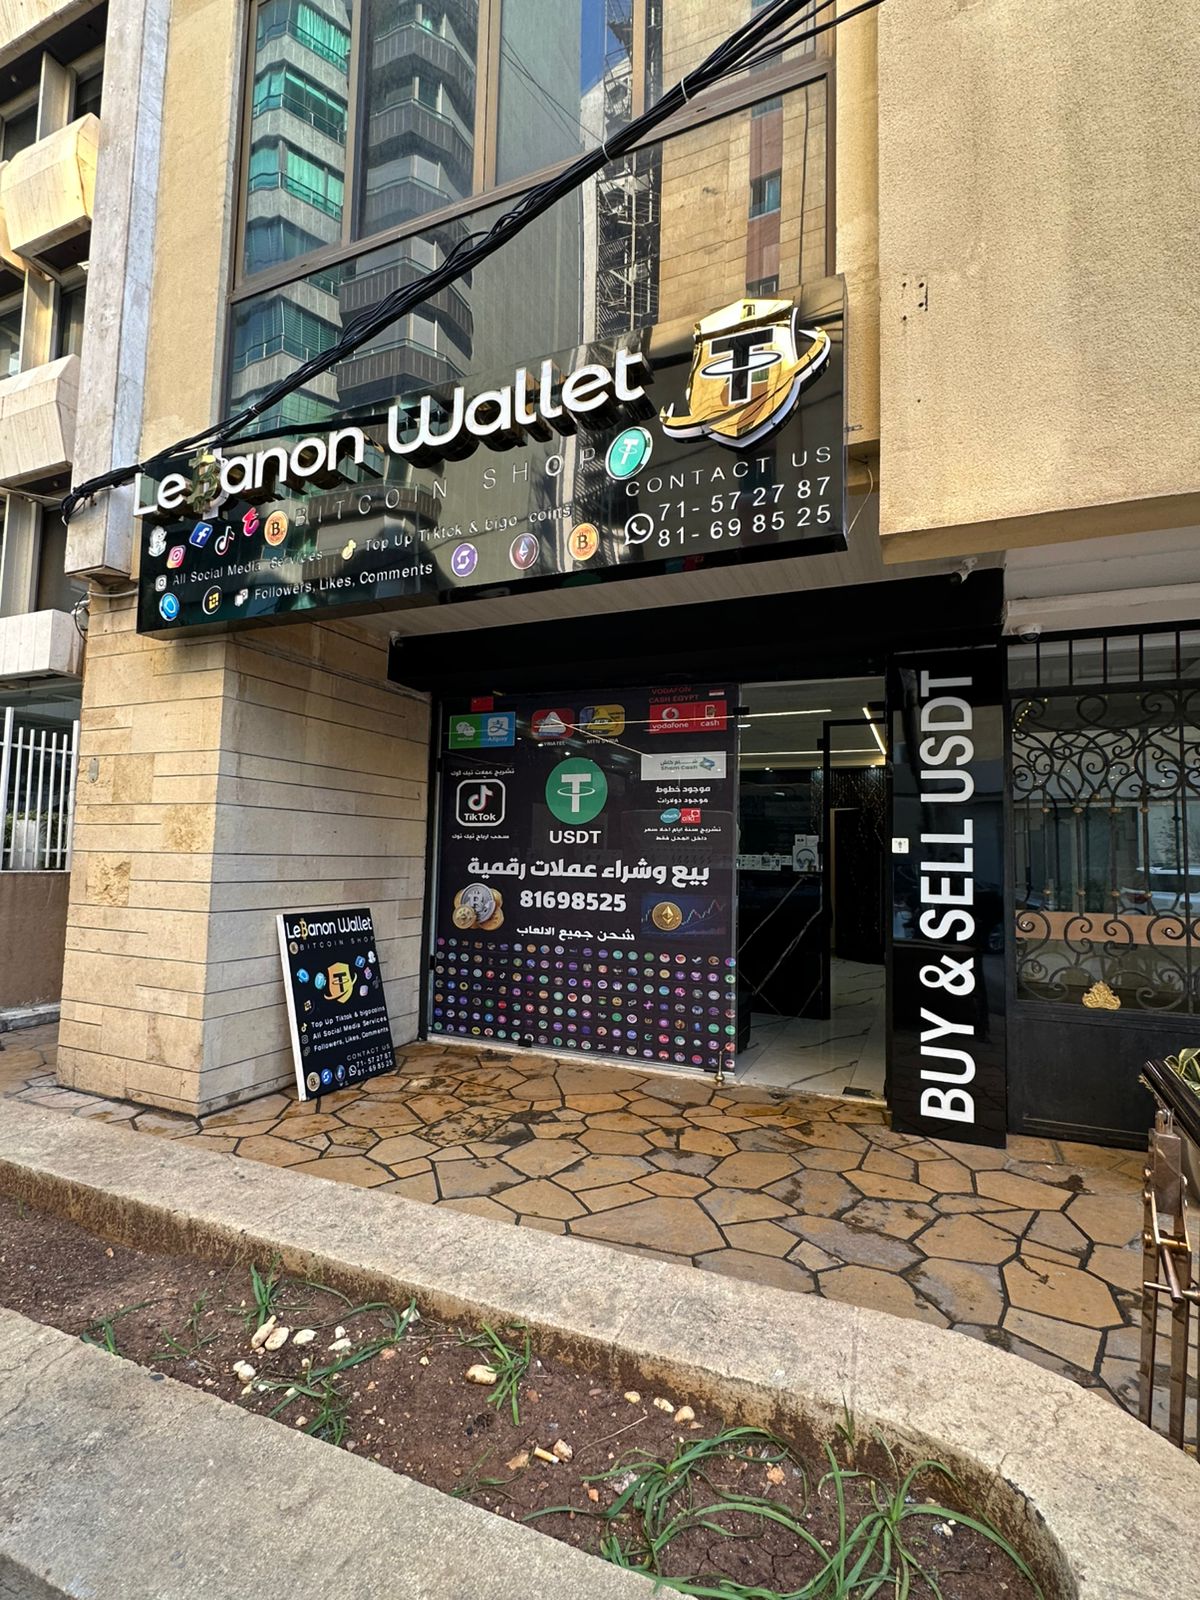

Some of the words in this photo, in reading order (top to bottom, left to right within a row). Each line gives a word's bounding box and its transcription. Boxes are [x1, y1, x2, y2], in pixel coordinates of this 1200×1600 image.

[388, 349, 645, 454] Wallet
[626, 457, 771, 496] CONTACT
[792, 447, 832, 468] US
[295, 480, 447, 527] BITCOIN
[483, 448, 596, 489] SHOP
[659, 496, 700, 521] 71-
[710, 490, 742, 513] 57
[752, 484, 785, 507] 27
[797, 477, 831, 500] 87
[366, 539, 389, 552] Top
[395, 534, 413, 547] Up
[469, 520, 479, 533] &
[485, 515, 518, 531] bigo
[530, 503, 572, 523] coins
[657, 523, 700, 548] 81-
[709, 518, 742, 540] 69
[752, 511, 785, 533] 85
[797, 504, 832, 527] 25
[173, 573, 186, 585] All
[190, 566, 223, 583] Social
[228, 562, 261, 576] Media
[255, 581, 315, 600] Followers,
[320, 575, 355, 591] Likes,
[360, 563, 433, 584] Comments
[652, 722, 689, 730] vodafone
[701, 719, 720, 727] cash
[919, 670, 975, 803] USDT
[682, 786, 711, 794] موجود
[464, 813, 496, 821] TikTok
[549, 830, 602, 844] USDT
[467, 857, 526, 880] رقمية
[530, 859, 597, 878] عملات
[602, 857, 667, 884] وشراء
[671, 864, 710, 888] بيع
[919, 818, 975, 942] SELL
[520, 890, 627, 913] 81698525
[337, 915, 373, 933] Wallet
[516, 925, 555, 937] الالعاب
[559, 928, 592, 942] جميع
[597, 928, 635, 942] شحن
[299, 940, 344, 951] BITCOIN
[919, 954, 976, 996] &
[311, 1021, 324, 1029] Top
[324, 1018, 334, 1026] Up
[312, 1032, 322, 1040] All
[323, 1027, 342, 1037] Social
[346, 1046, 379, 1061] CONTACT
[920, 1007, 976, 1124] BUY
